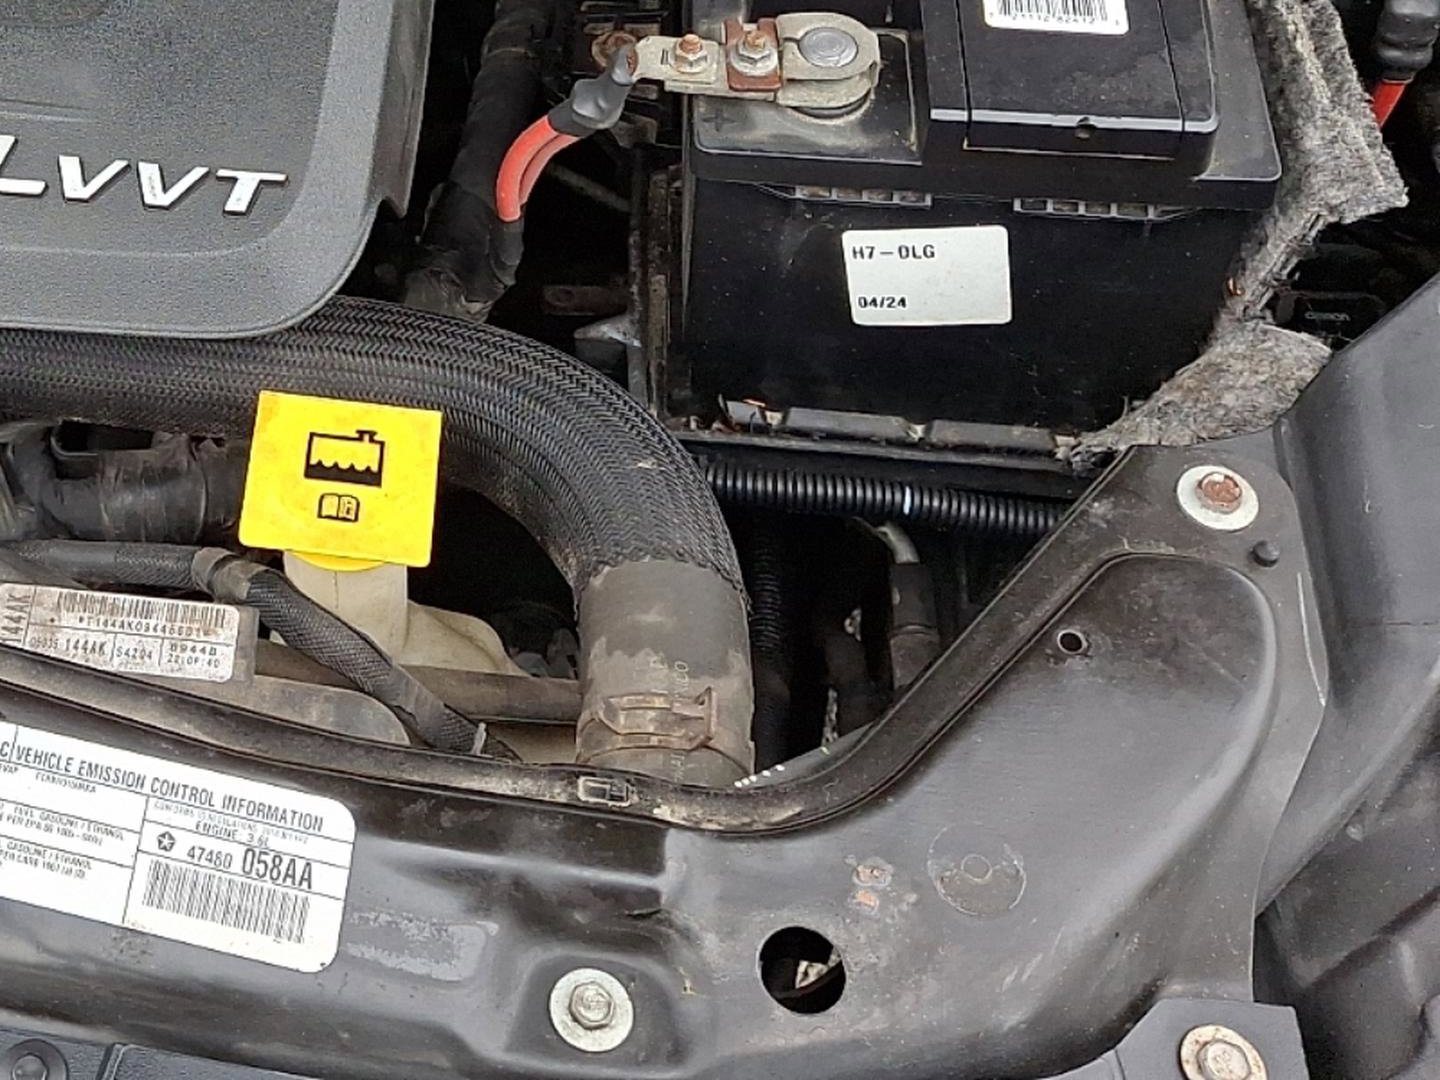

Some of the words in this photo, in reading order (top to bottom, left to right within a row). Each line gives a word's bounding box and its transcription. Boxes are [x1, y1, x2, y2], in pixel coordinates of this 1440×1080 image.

[58, 154, 289, 216] VVT
[857, 296, 908, 309] 04/24
[65, 638, 107, 658] 144AK
[16, 746, 74, 773] VEHICLE
[78, 760, 146, 789] EMISSION
[150, 777, 214, 807] CONTROL
[222, 795, 323, 831] INFORMATION
[241, 847, 313, 890] 058AA
